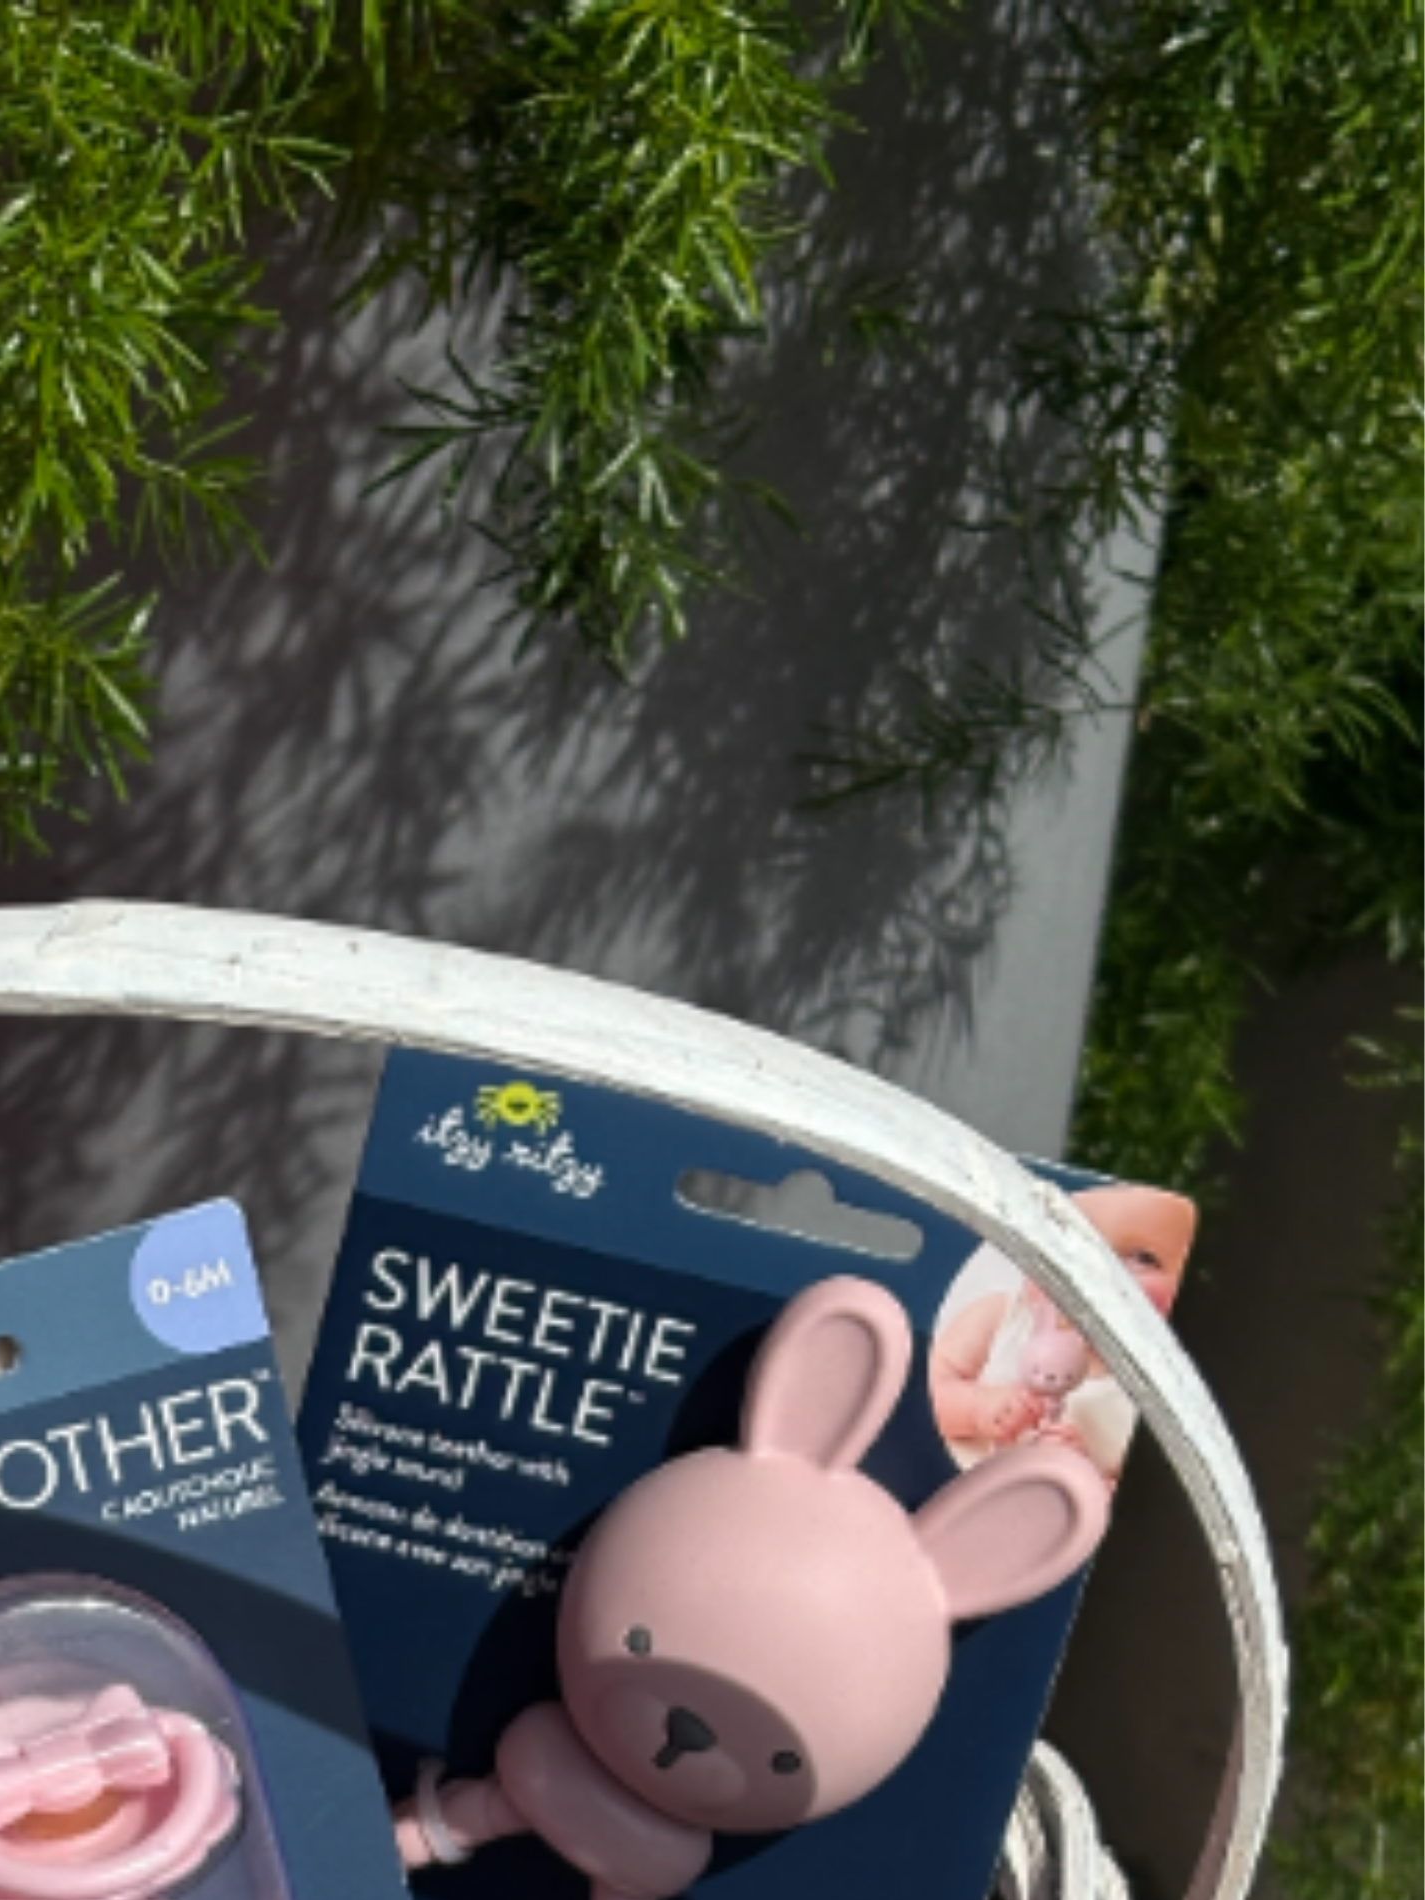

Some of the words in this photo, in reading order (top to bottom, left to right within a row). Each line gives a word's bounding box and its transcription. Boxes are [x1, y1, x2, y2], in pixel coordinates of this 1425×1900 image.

[146, 1257, 235, 1306] 0-6M
[364, 1247, 697, 1386] SWEETIE
[346, 1323, 625, 1447] RATTLE
